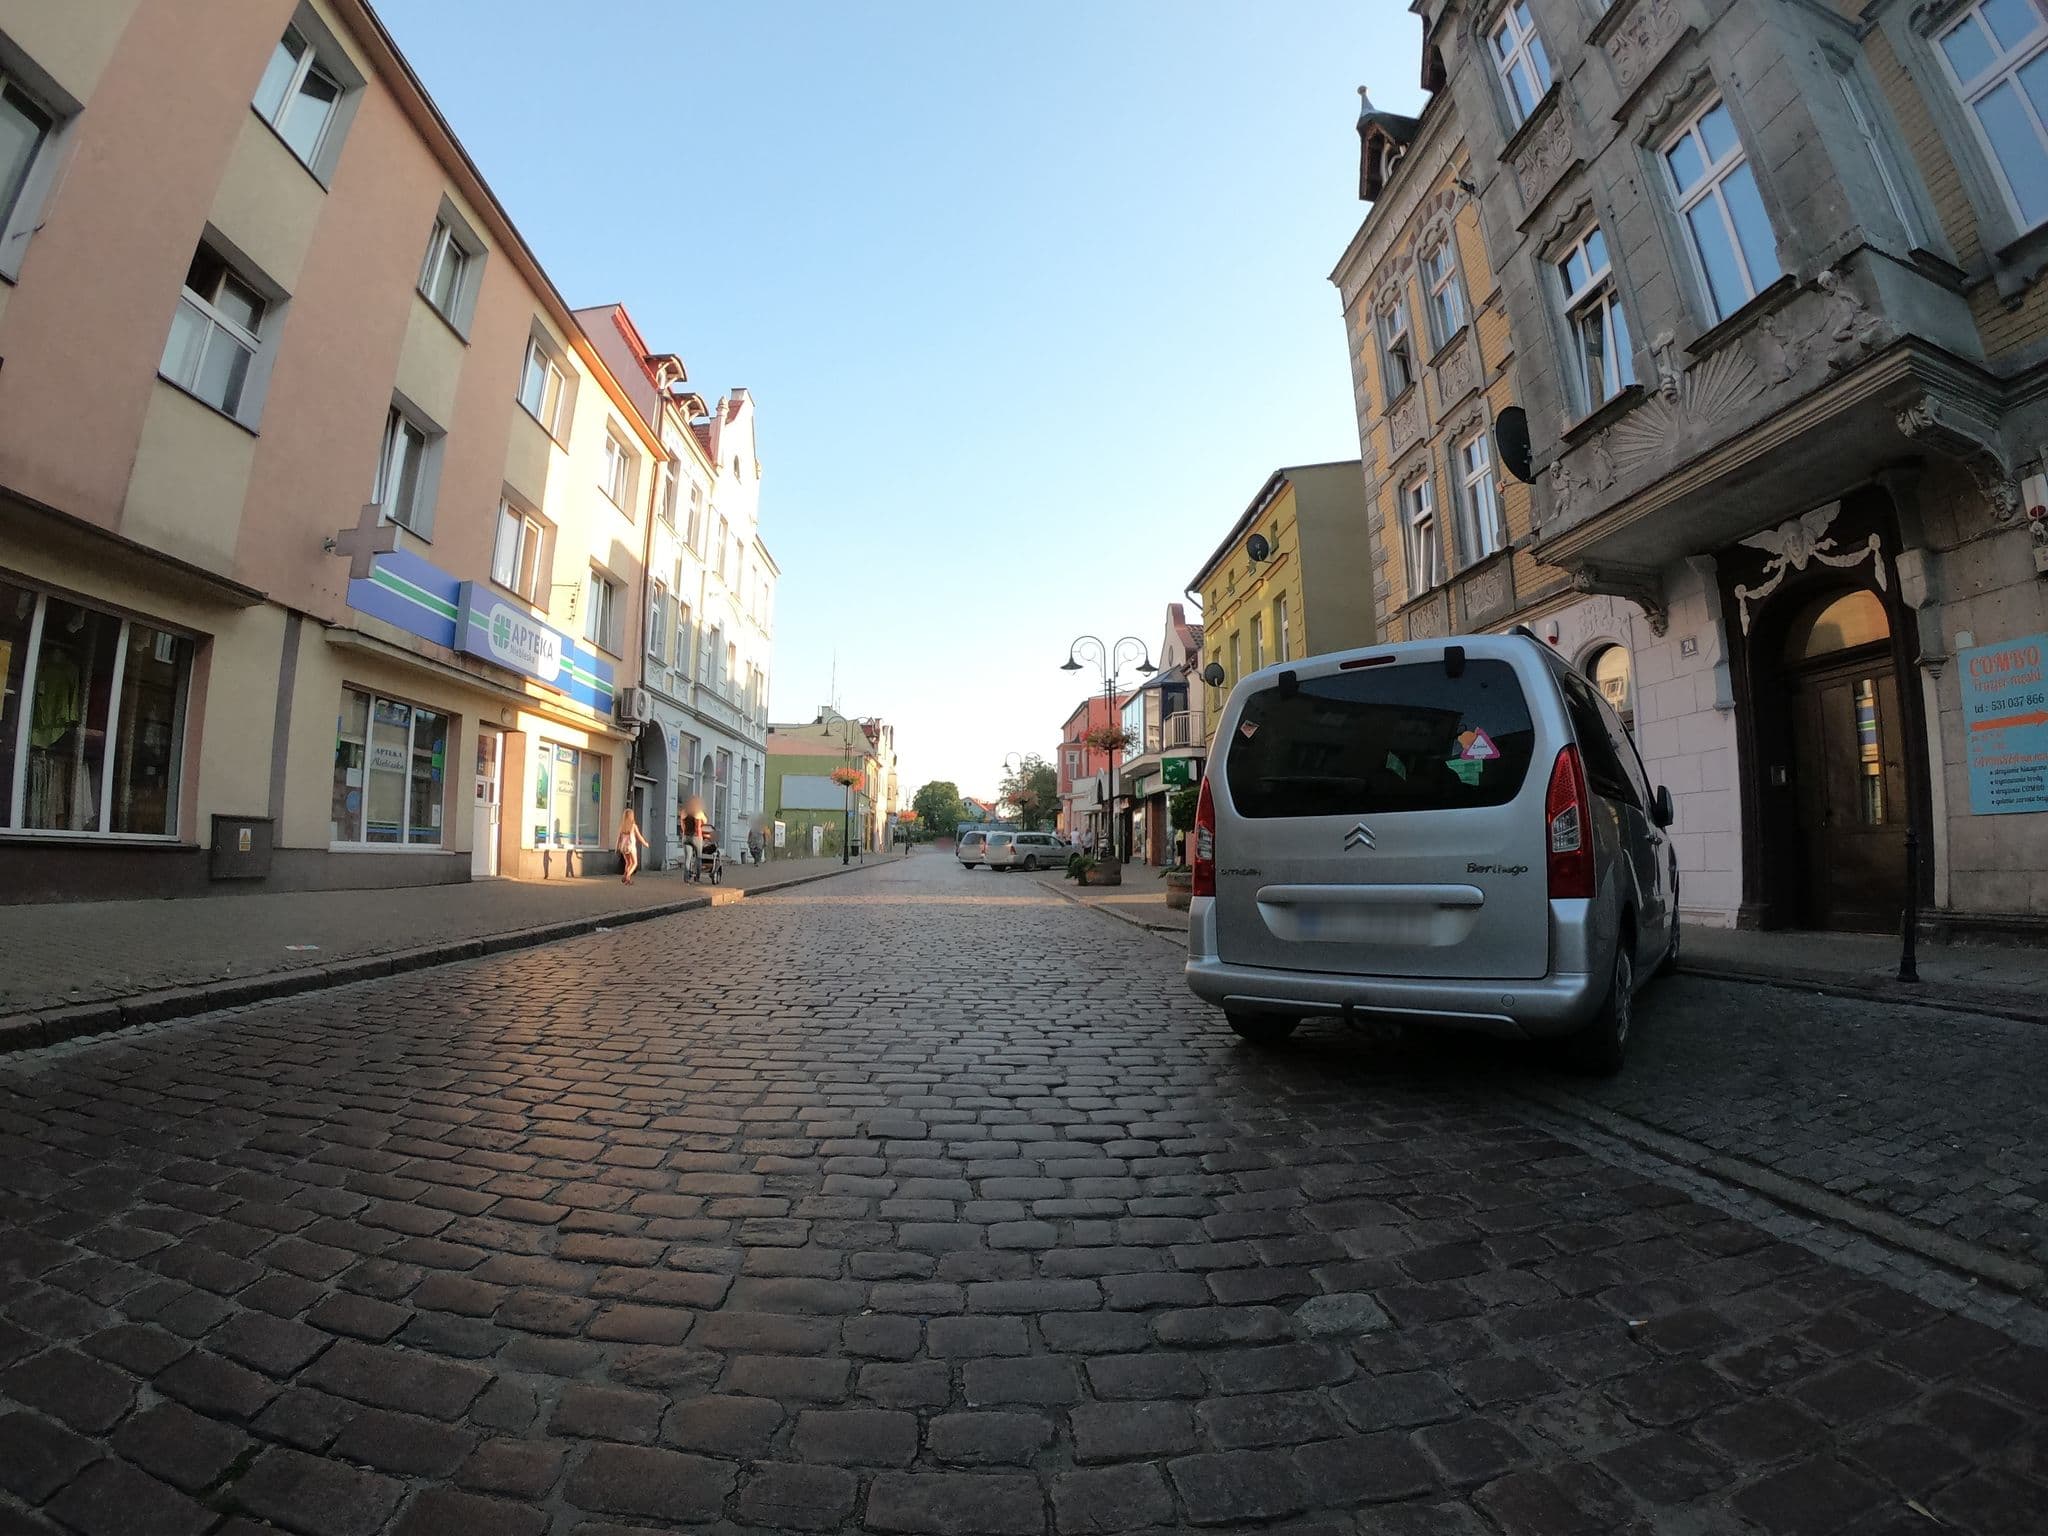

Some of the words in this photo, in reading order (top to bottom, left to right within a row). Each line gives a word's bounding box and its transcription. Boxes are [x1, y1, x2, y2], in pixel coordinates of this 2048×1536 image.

[512, 623, 553, 660] APTEKA
[1970, 646, 2040, 678] COMBO
[1991, 699, 2006, 711] 531
[2007, 695, 2024, 709] 037
[2026, 693, 2045, 706] 866
[375, 748, 402, 758] APTEKA
[1466, 862, 1529, 877] Berlingo
